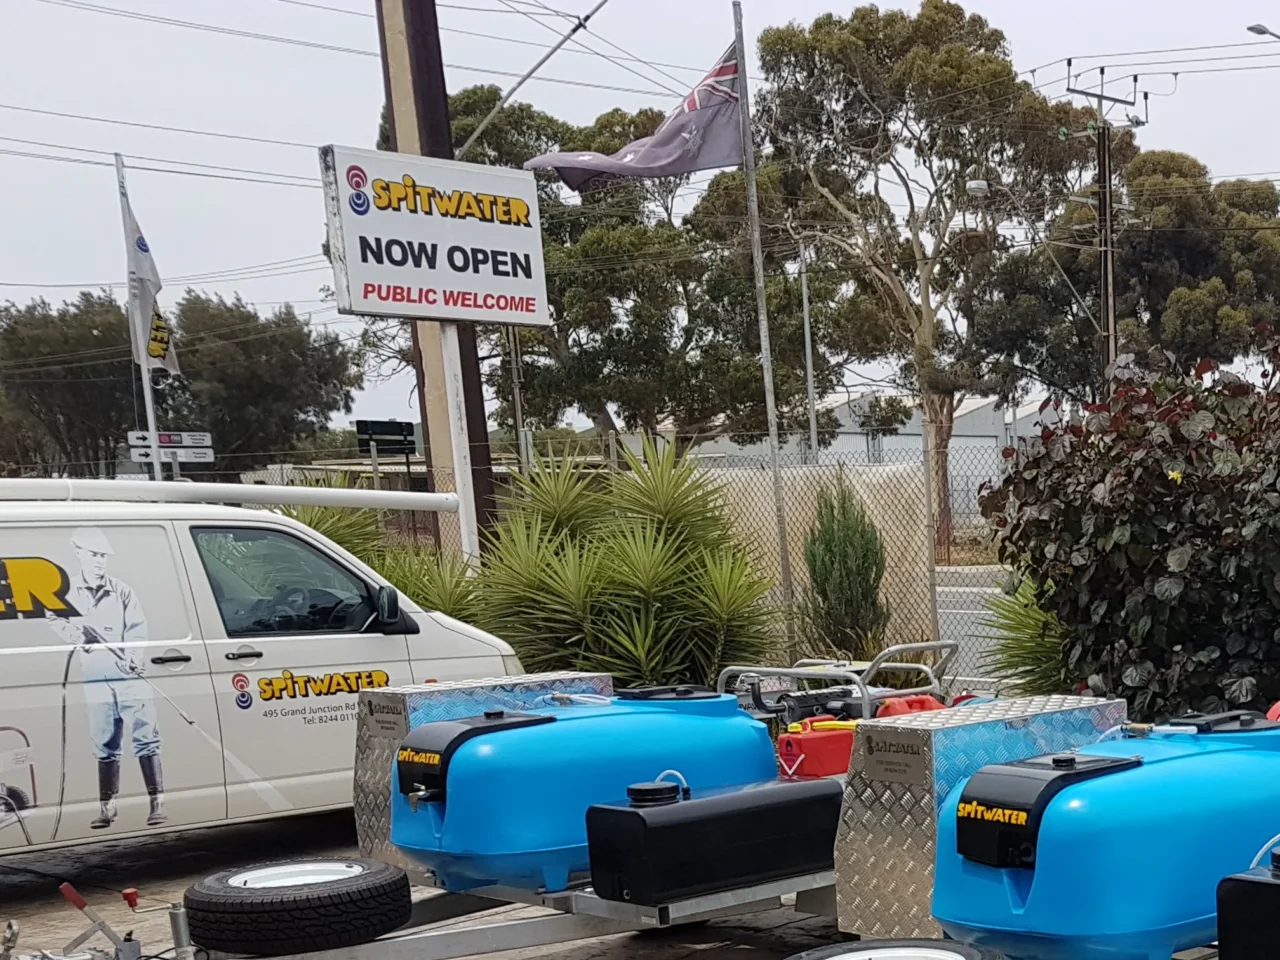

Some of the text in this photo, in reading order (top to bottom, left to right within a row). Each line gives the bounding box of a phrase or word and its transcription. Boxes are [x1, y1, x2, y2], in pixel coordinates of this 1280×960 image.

[358, 235, 532, 279] NOW OPEN
[363, 283, 536, 313] PUBLIC WELCOME
[262, 702, 356, 718] 495 Grand Junction Rd
[302, 712, 360, 725] Tel: 8244 0110
